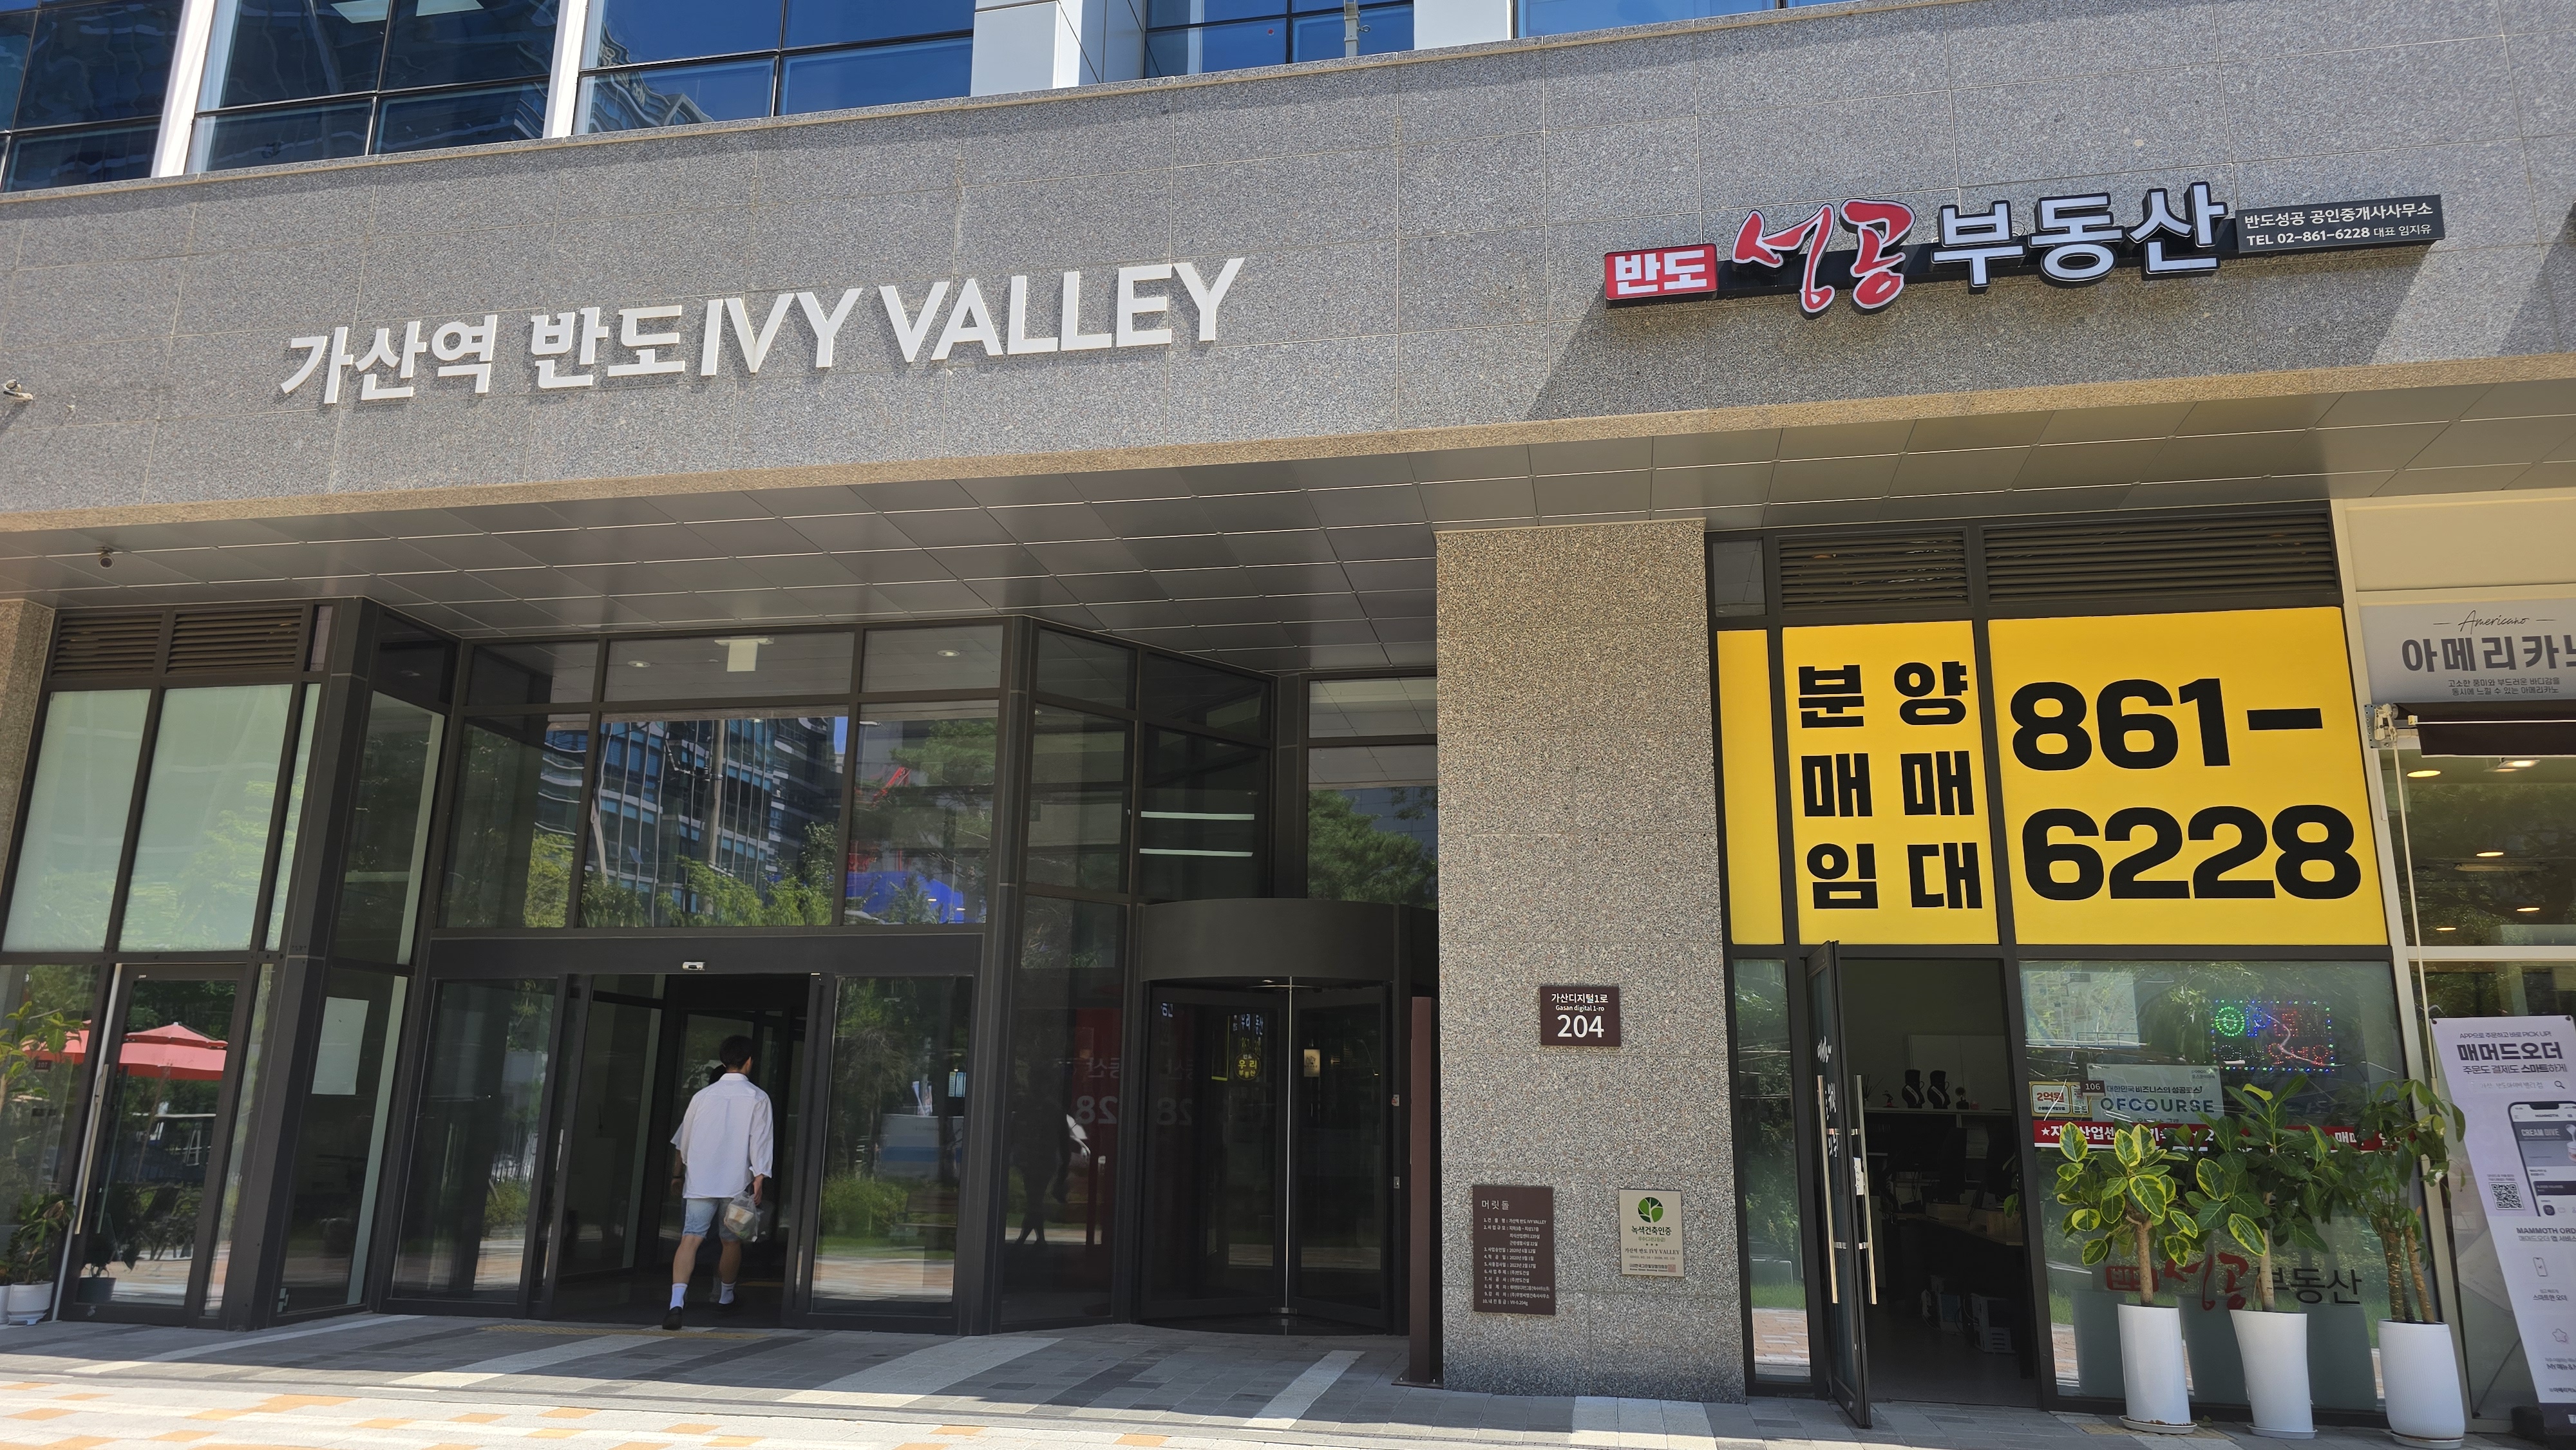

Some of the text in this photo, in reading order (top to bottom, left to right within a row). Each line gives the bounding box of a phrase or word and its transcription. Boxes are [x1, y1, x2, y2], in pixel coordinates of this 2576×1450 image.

[2244, 202, 2433, 229] 반도성공 공인중개사사무소
[2246, 224, 2432, 246] TEL 02-861-6228 대표 임지유
[1615, 182, 2229, 318] 반도 성공 부동산
[281, 258, 1245, 405] 가산역 반도 IVY VALLEY
[2457, 610, 2530, 635] Americano
[2472, 679, 2496, 687] 풍미와
[2497, 678, 2528, 686] 부드러운
[2452, 688, 2475, 696] 동시에
[2477, 687, 2492, 695] 느낄
[2521, 686, 2560, 694] 아메리카노
[2022, 804, 2362, 901] 6228
[1551, 993, 1609, 1003] 가산디지털1로
[1574, 1004, 1593, 1013] digital
[1557, 1014, 1605, 1038] 204
[2456, 1041, 2564, 1061] 매머드오더
[1238, 1059, 1258, 1069] 우리
[2462, 1063, 2568, 1075] 주문도 결제도 스마트하게
[2106, 1085, 2135, 1093] 대한민국
[2100, 1097, 2215, 1113] OFCOURSE
[2051, 1125, 2116, 1140] 지산업센
[1631, 1225, 1672, 1236] 녹색건축인증
